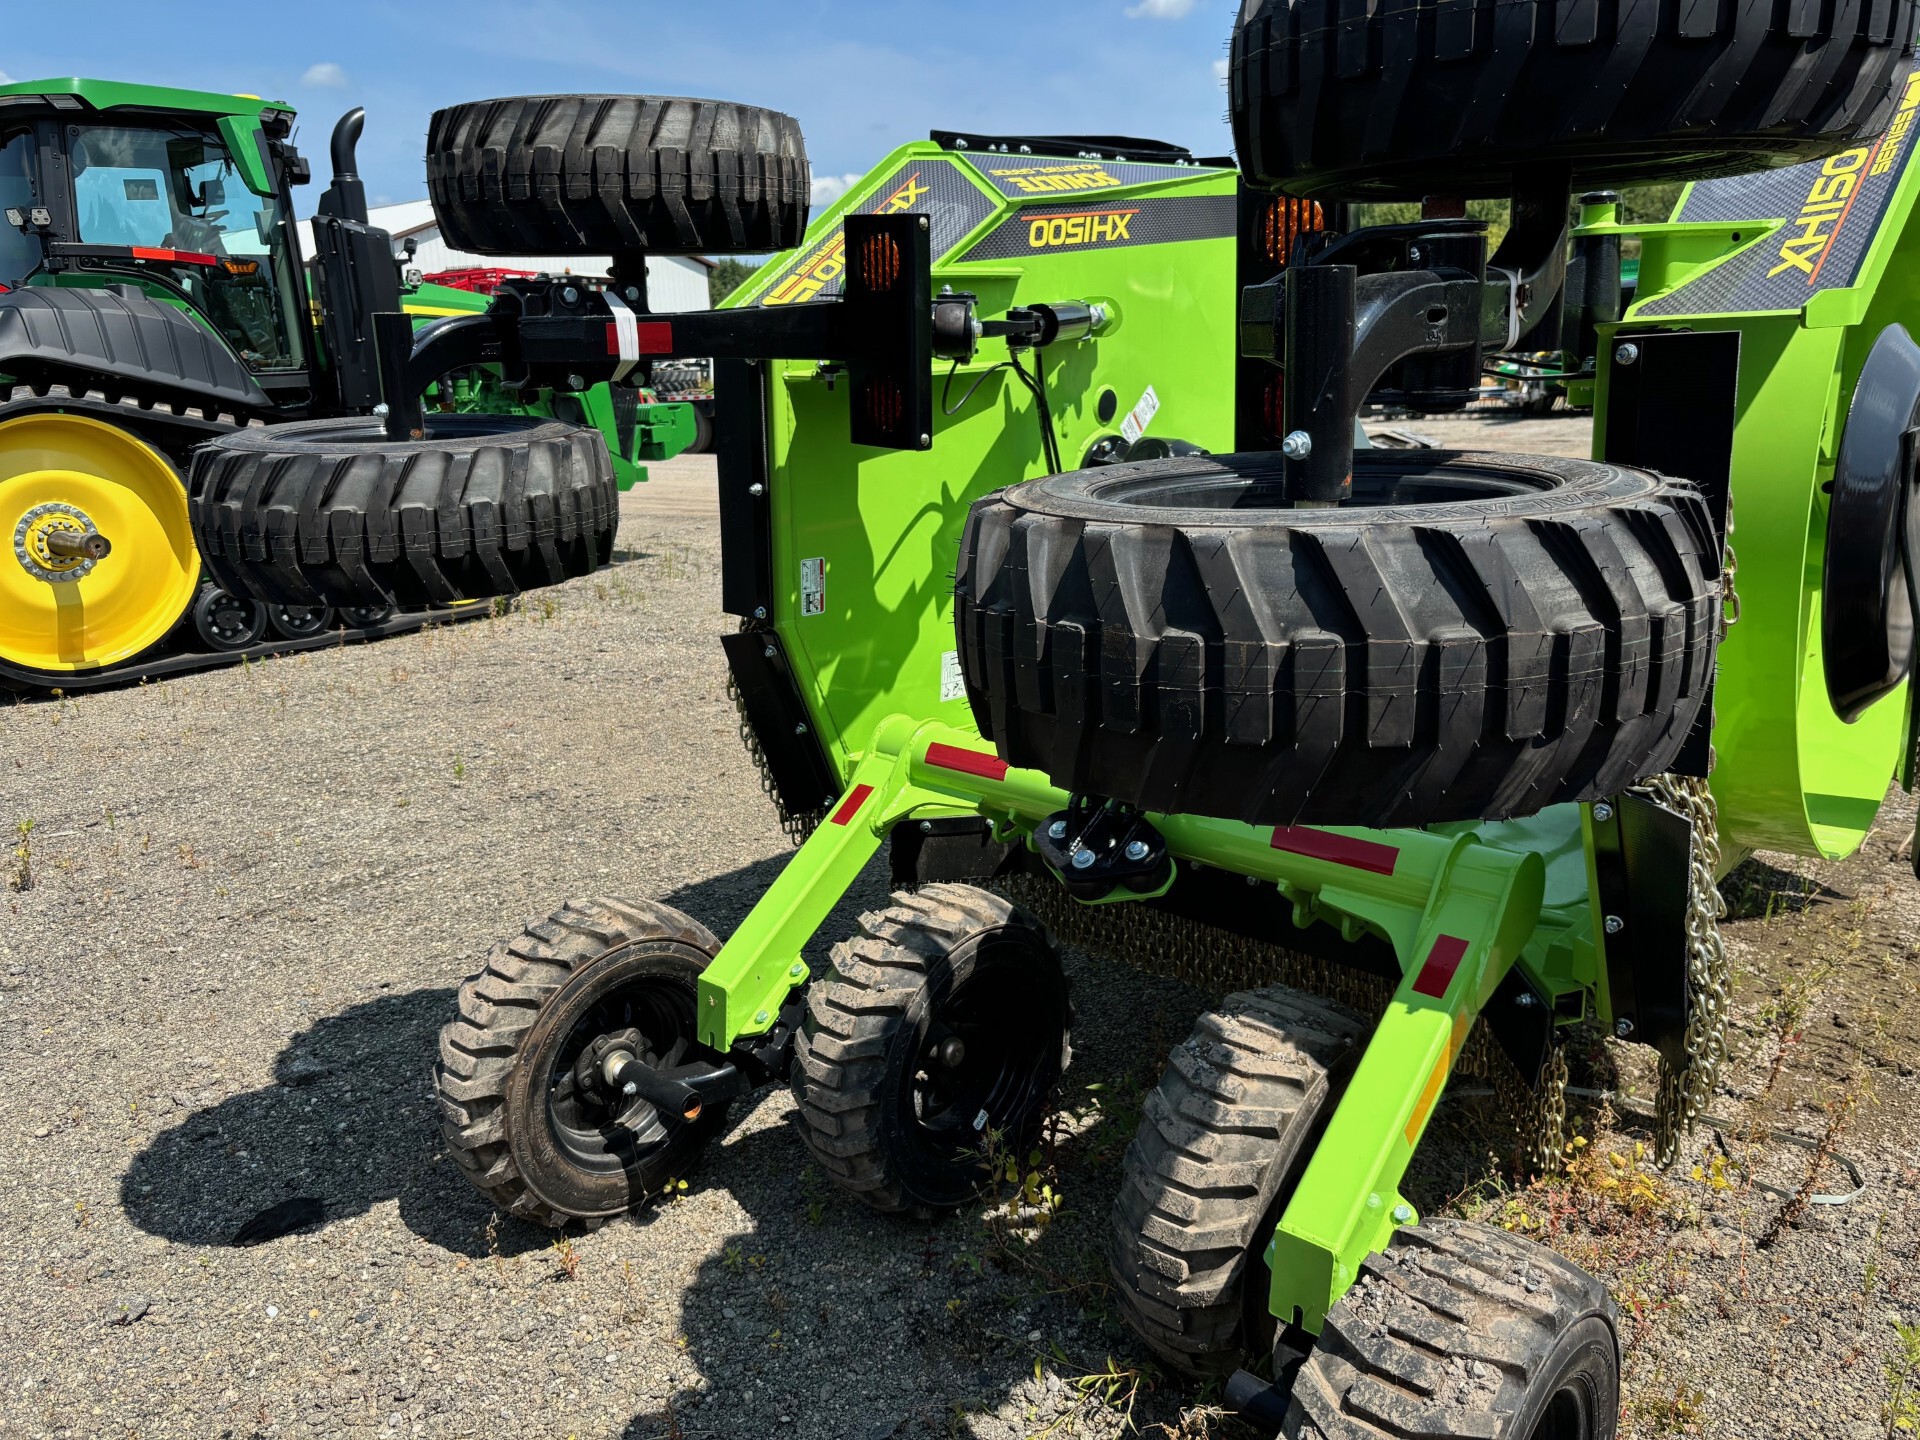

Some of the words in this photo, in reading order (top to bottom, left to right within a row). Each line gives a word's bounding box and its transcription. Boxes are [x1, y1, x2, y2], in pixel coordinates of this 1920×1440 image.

[1869, 109, 1916, 176] SERIES
[1007, 171, 1121, 192] SCHULTE
[1029, 213, 1133, 248] XH1500
[1766, 147, 1869, 279] XH150
[796, 231, 845, 275] SERIES
[1370, 490, 1612, 522] GALAXY
